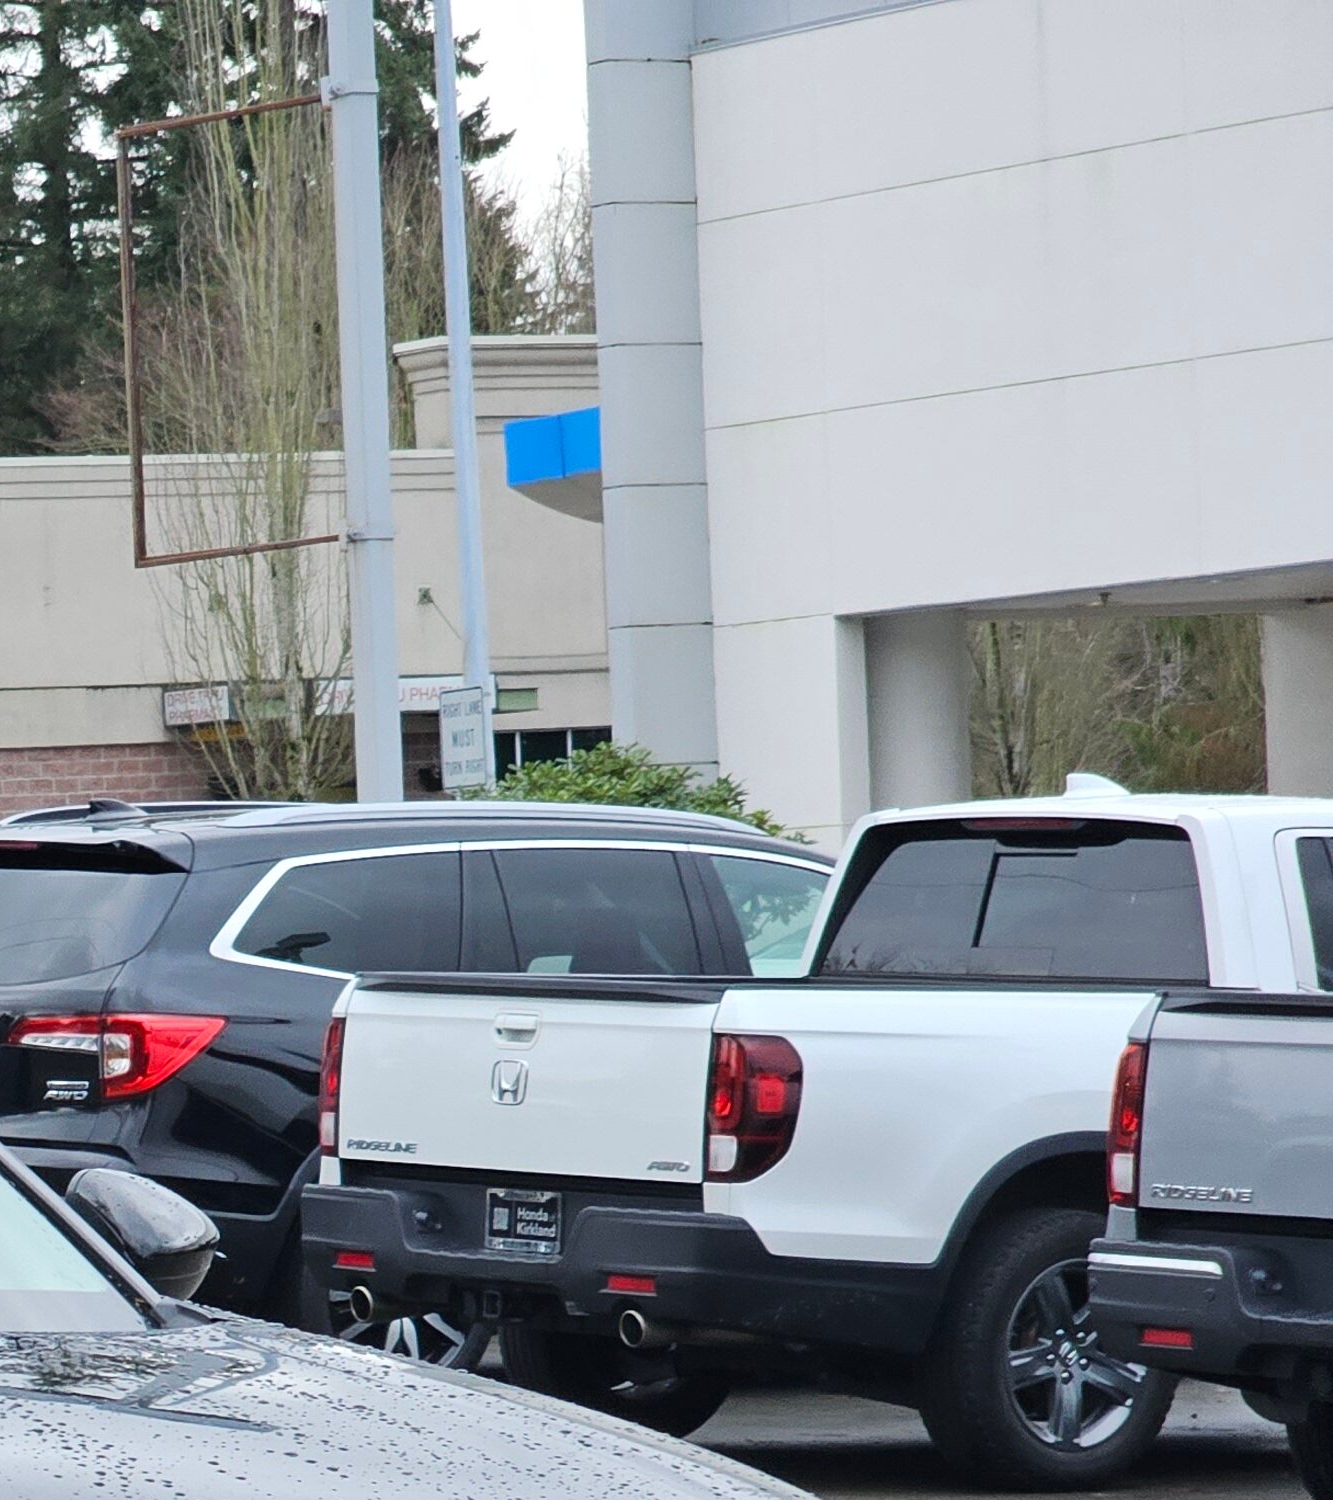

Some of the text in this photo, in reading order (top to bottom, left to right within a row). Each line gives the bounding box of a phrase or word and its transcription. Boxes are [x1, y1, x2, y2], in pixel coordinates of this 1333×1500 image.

[452, 728, 475, 748] MUST
[1151, 1183, 1253, 1203] RIDGELINE
[517, 1206, 548, 1222] Honda
